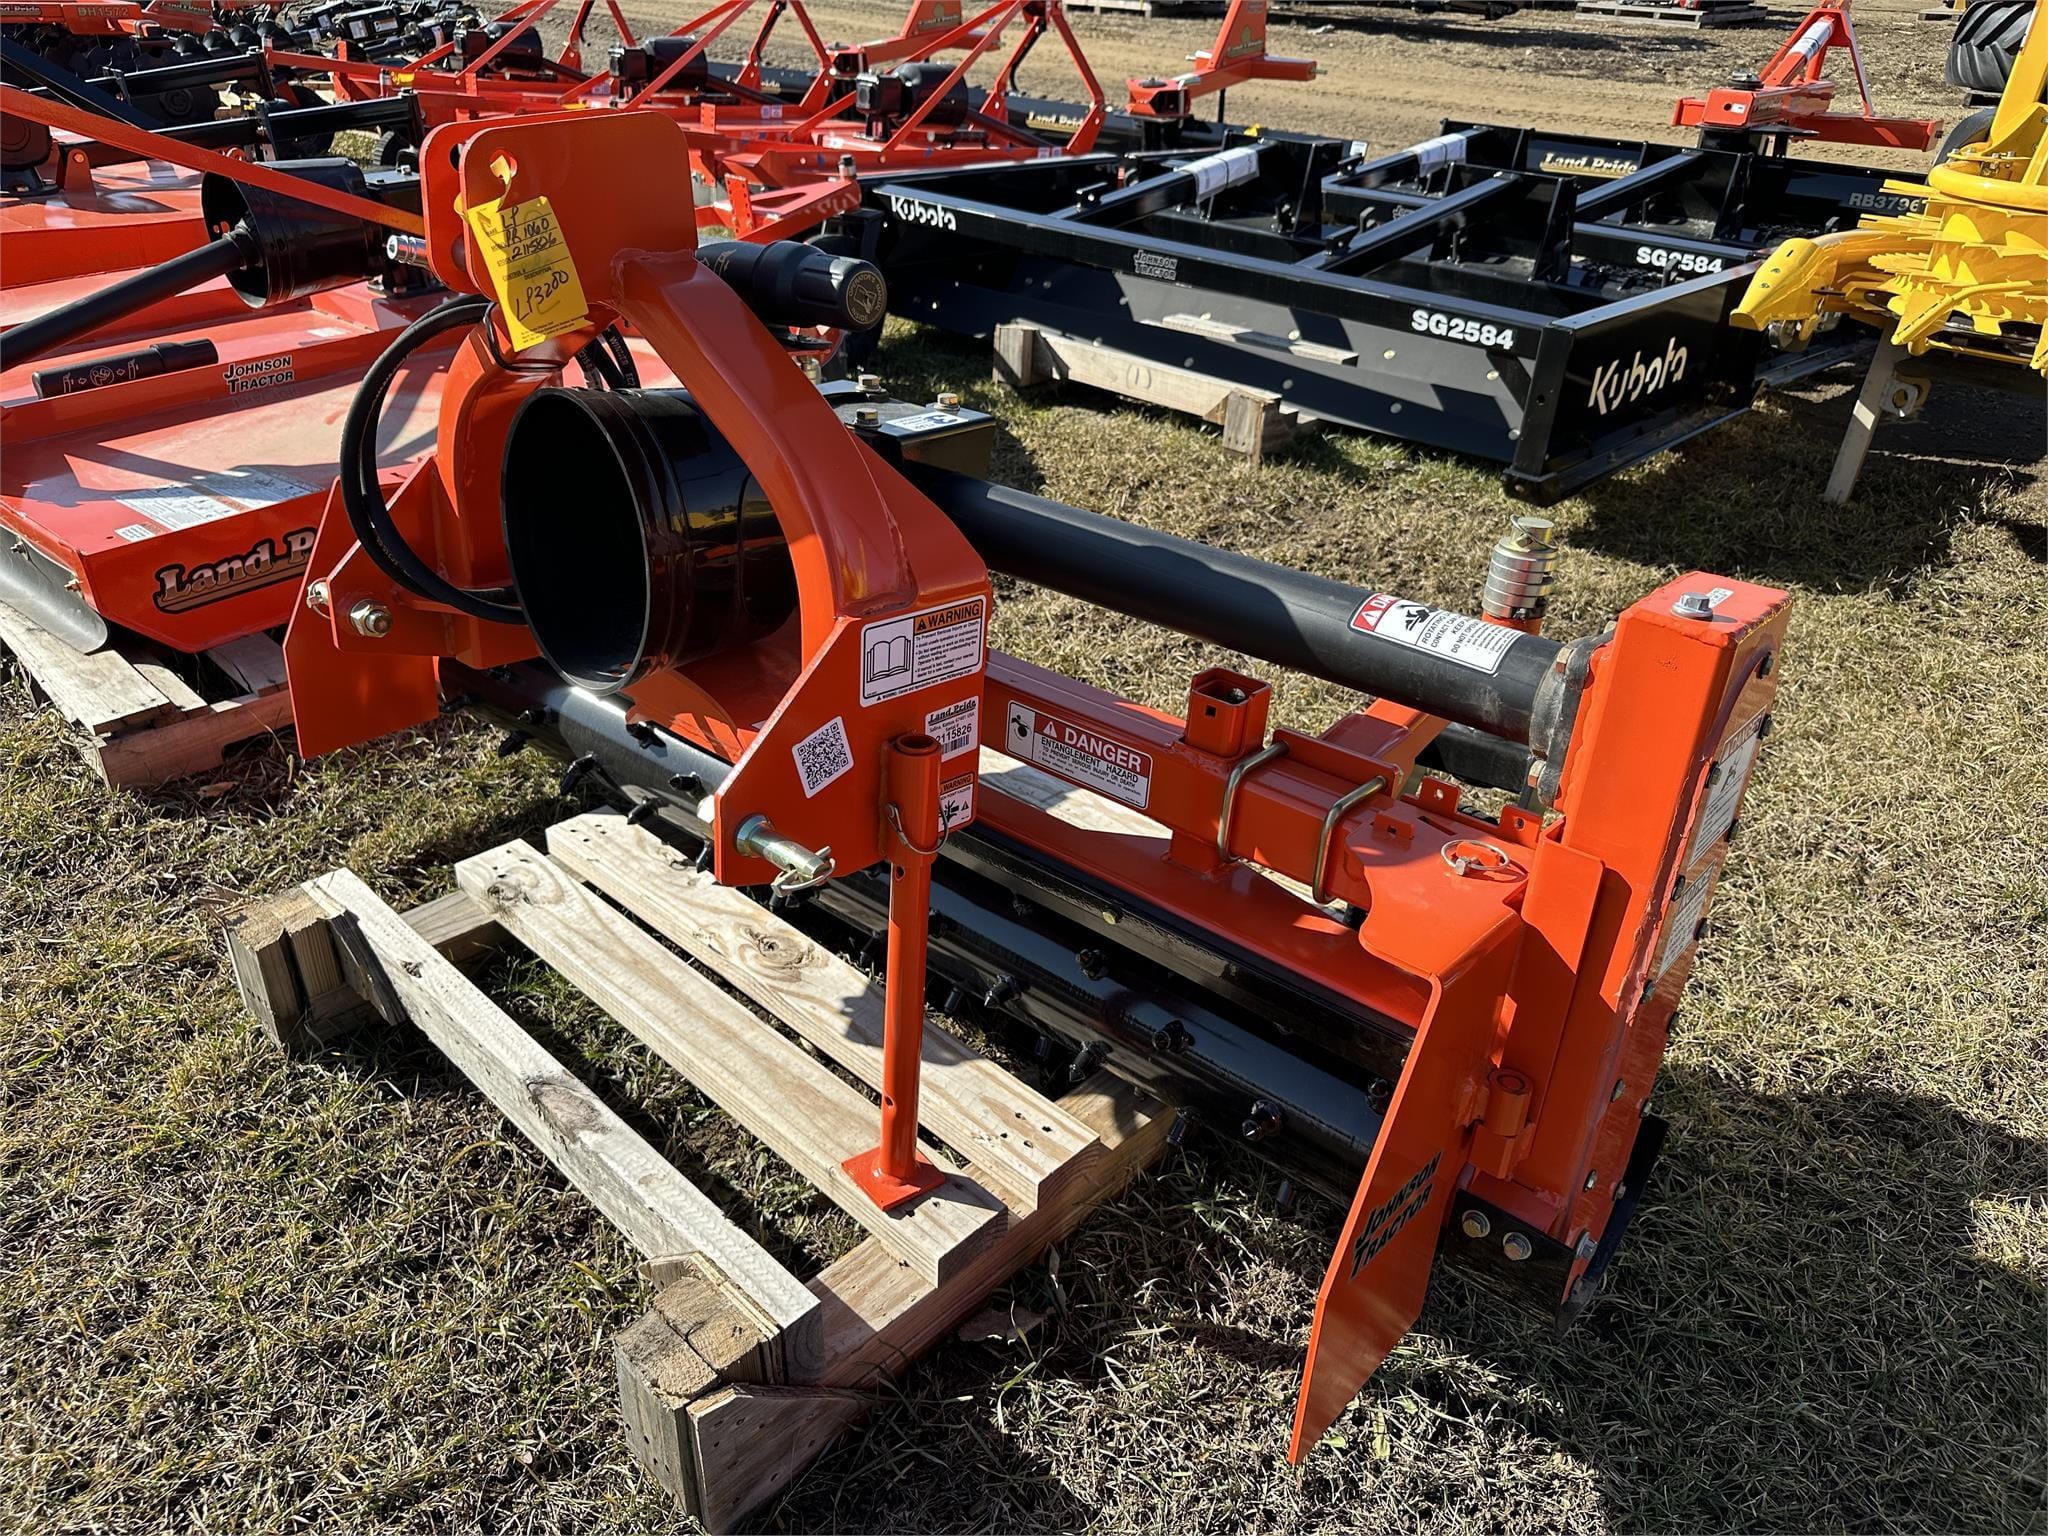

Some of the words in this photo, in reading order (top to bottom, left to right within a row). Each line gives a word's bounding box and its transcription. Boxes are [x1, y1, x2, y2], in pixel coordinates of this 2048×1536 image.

[1543, 152, 1588, 170] Land
[1590, 157, 1638, 175] Pride
[890, 194, 957, 231] Kubota
[1848, 192, 1921, 213] RB3796
[1411, 308, 1515, 351] SG2584
[222, 355, 293, 379] JOHNSON
[227, 371, 295, 395] TRACTOR
[1587, 336, 1689, 416] Kubota
[156, 540, 274, 602] Land
[927, 603, 980, 628] WARNING
[928, 706, 952, 727] Land
[953, 699, 977, 715] Pride
[936, 723, 972, 743] 2115826
[1064, 727, 1142, 773] DANGER
[1041, 737, 1101, 768] ENTANGLEMENT
[1106, 763, 1139, 783] HAZARD
[1354, 1150, 1443, 1252] JOHNSON
[1350, 1182, 1433, 1280] TRACTOR
